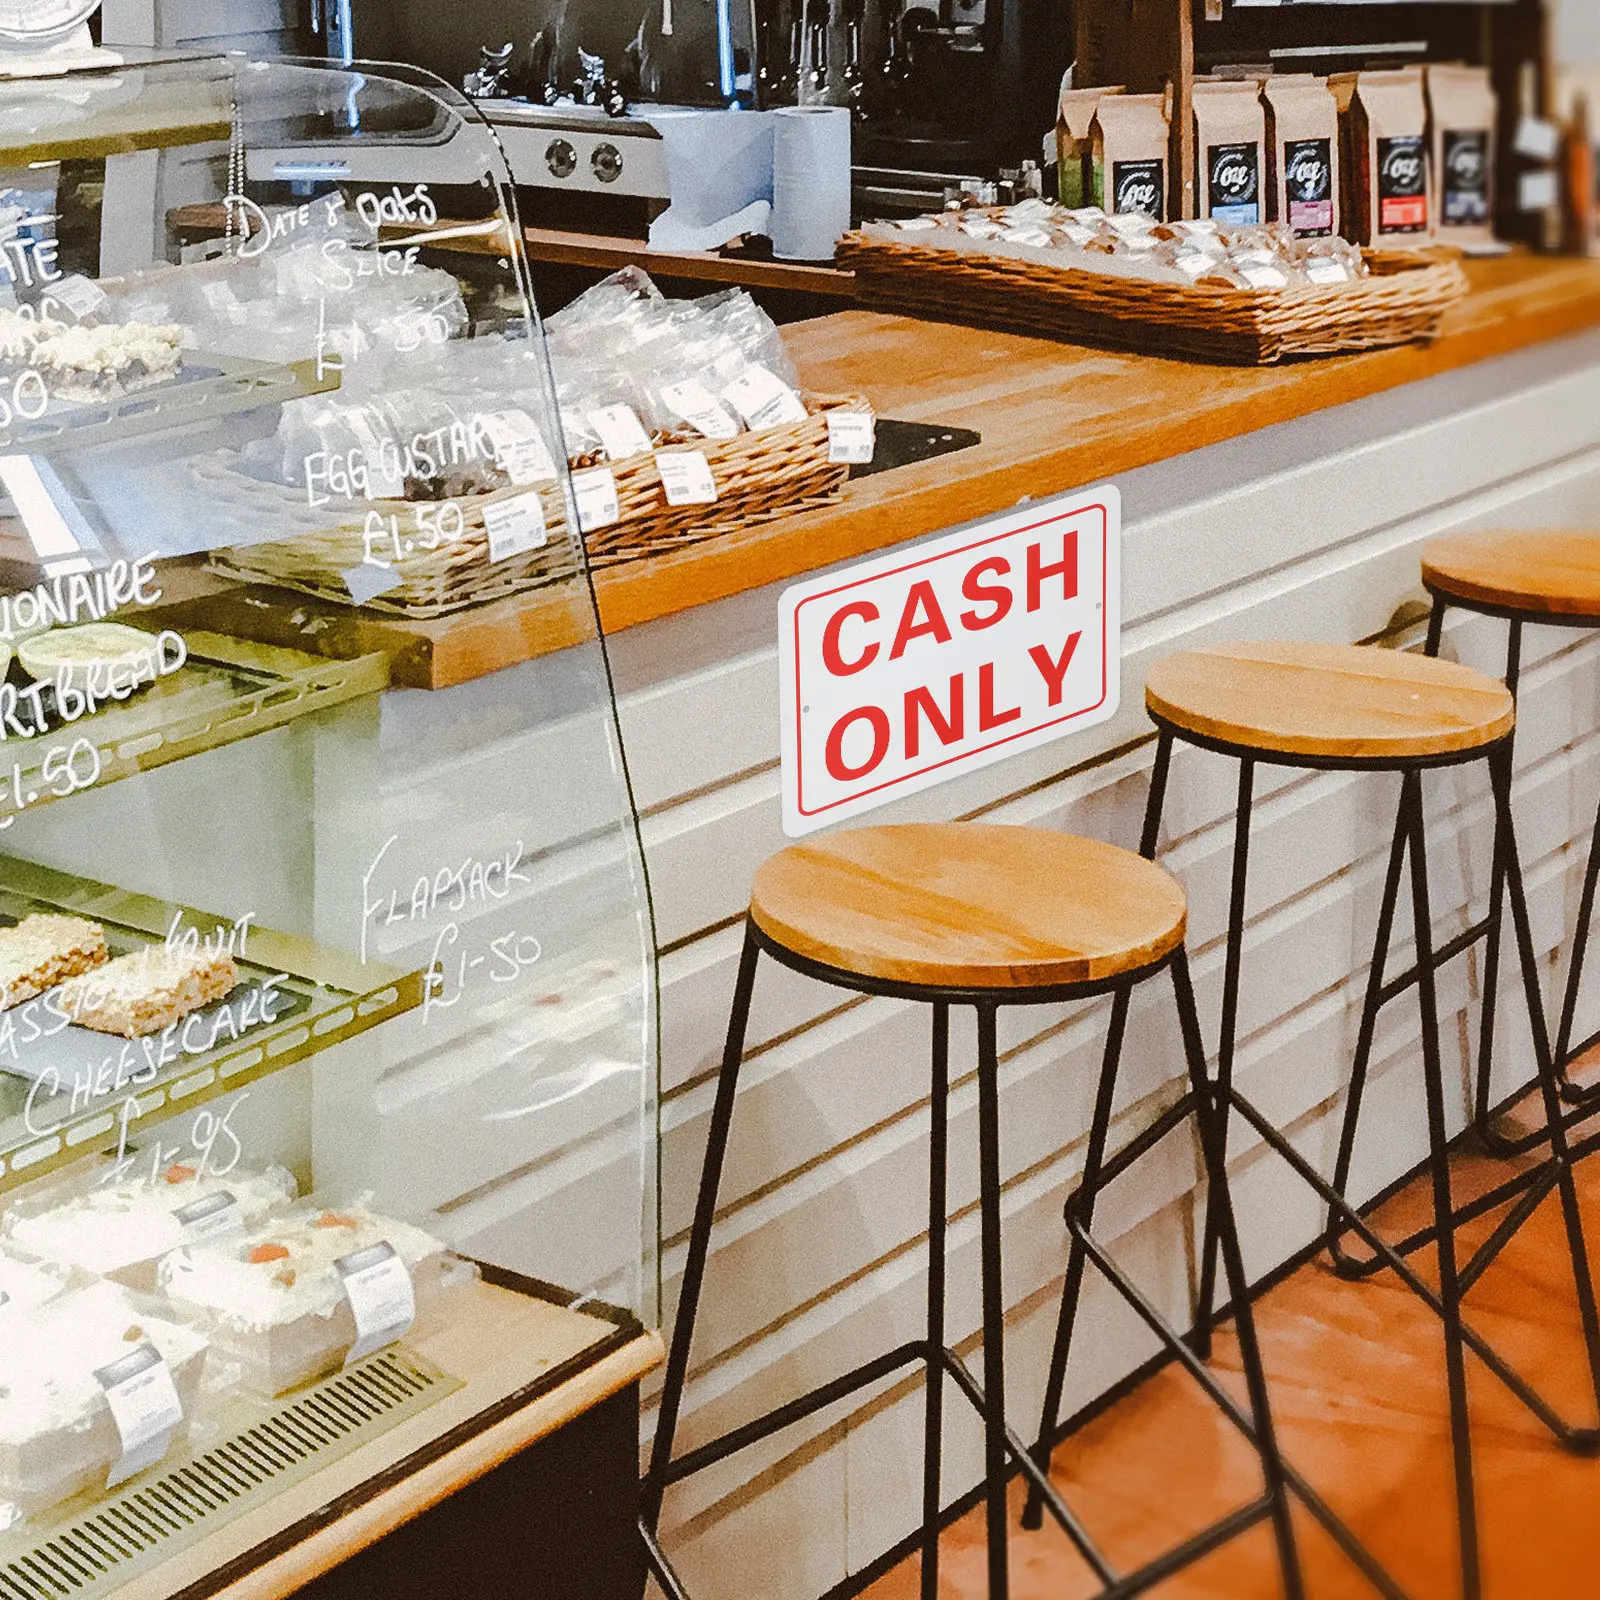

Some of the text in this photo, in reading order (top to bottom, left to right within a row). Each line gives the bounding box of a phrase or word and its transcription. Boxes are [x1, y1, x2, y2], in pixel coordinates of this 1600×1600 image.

[223, 194, 310, 257] DATE
[308, 238, 420, 291] SLICE
[303, 450, 375, 508] EGG
[378, 411, 508, 482] CUSTAR
[362, 501, 464, 569] £1.50
[821, 529, 1079, 677] CASH
[824, 629, 1083, 782] ONLY
[0, 738, 101, 829] 1.50
[360, 834, 532, 966] FLAPJACK
[24, 972, 290, 1137] CHEESECAKE
